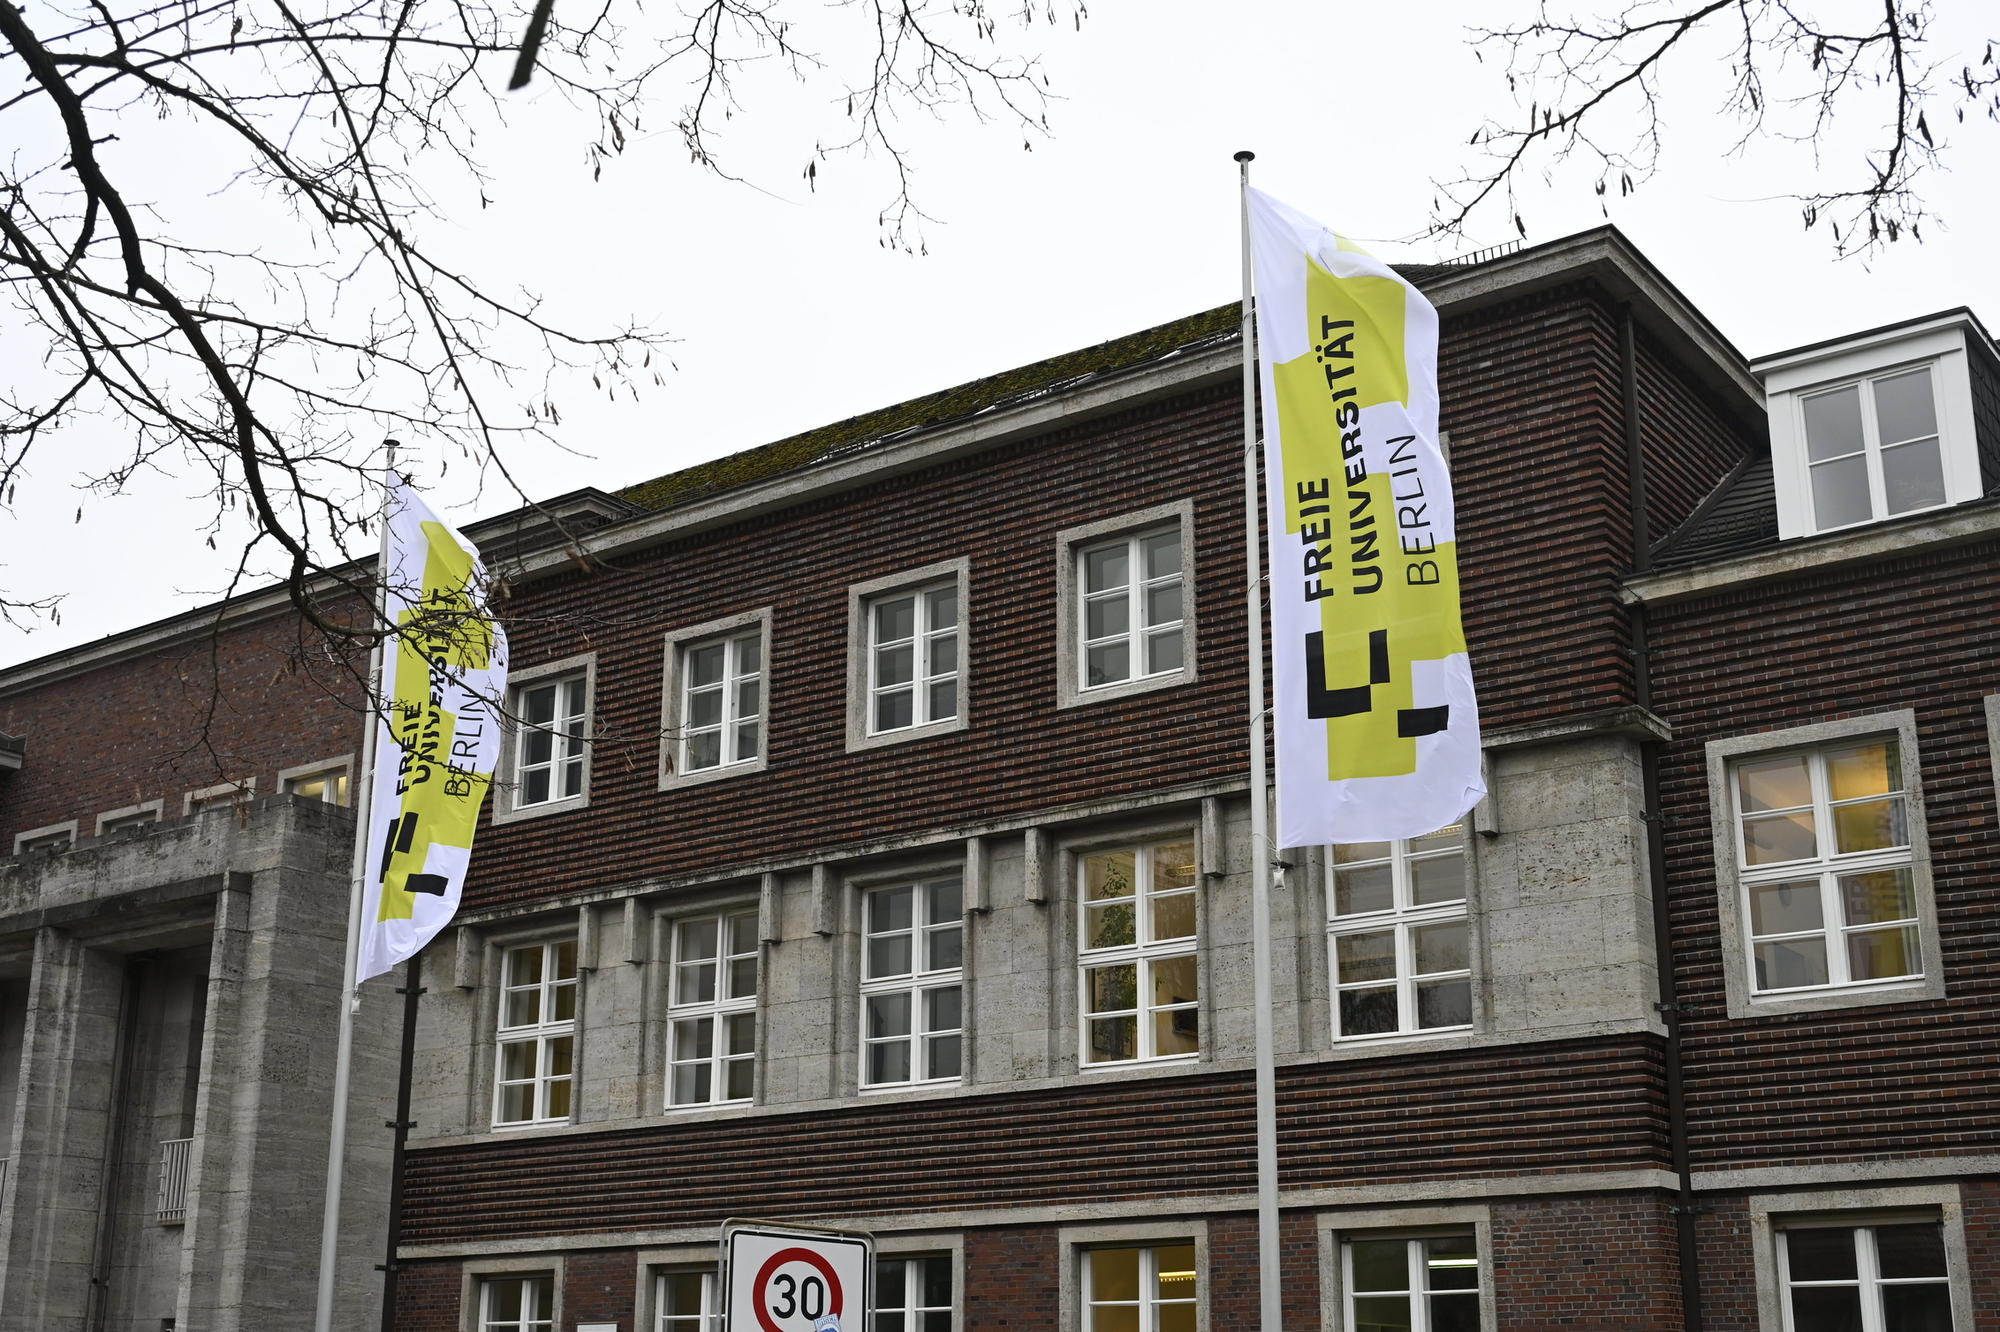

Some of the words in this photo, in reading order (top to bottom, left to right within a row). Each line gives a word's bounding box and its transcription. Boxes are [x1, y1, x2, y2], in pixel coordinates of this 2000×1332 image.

[1315, 315, 1383, 595] UNIVERSITÄT
[1386, 435, 1440, 586] BERLIN
[1297, 478, 1334, 602] FREIE
[396, 701, 422, 796] FREIE
[444, 692, 487, 797] BERLIN
[772, 1273, 824, 1321] 30
